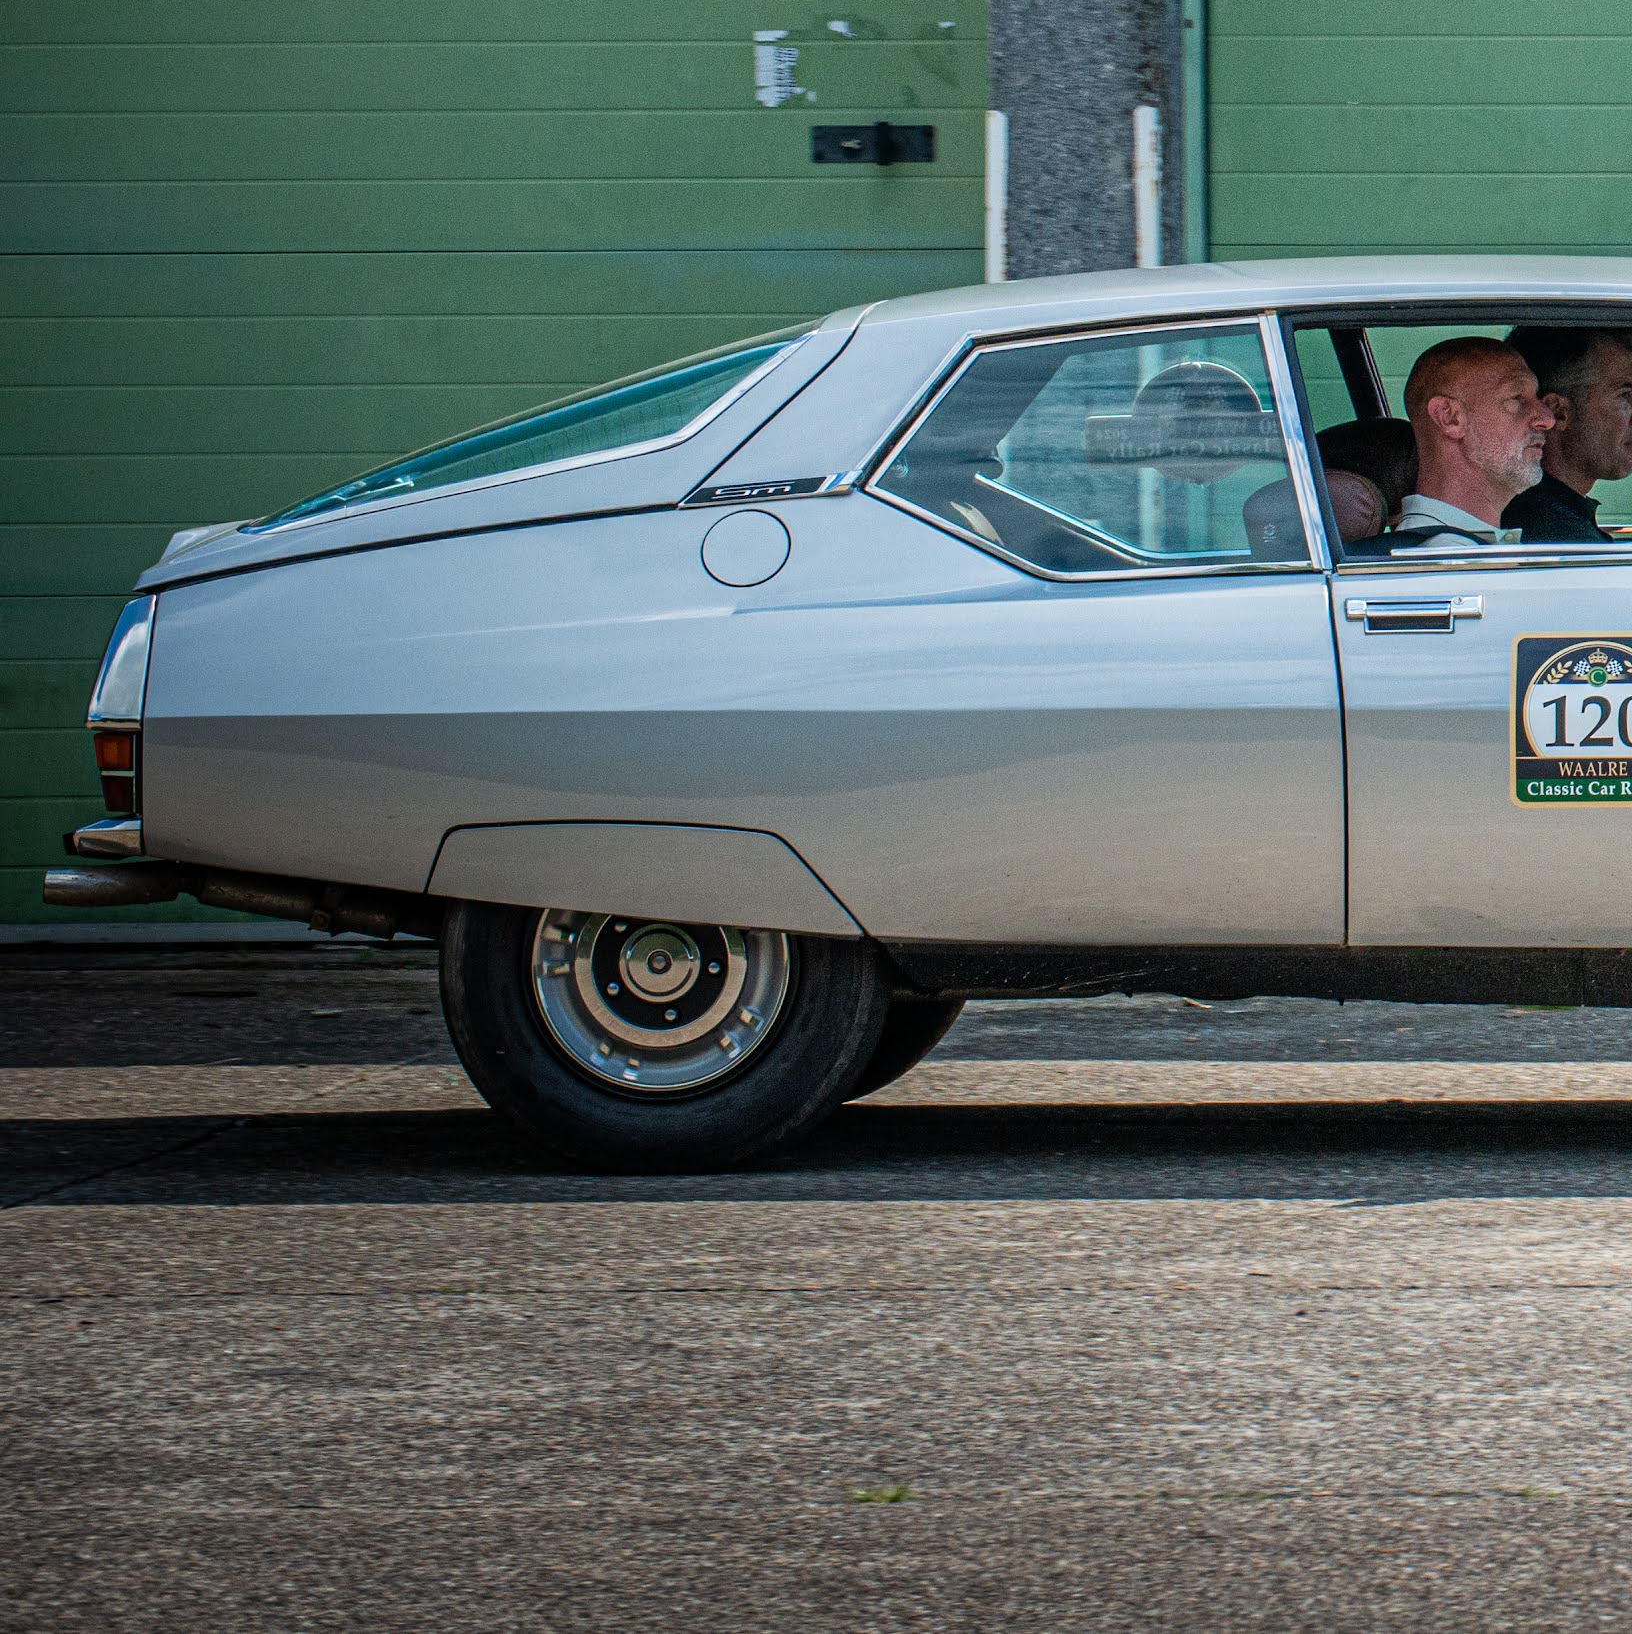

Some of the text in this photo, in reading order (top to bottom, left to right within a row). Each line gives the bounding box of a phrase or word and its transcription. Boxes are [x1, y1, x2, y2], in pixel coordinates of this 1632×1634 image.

[1558, 761, 1628, 777] WAALRE
[1527, 781, 1583, 796] Classic
[1588, 781, 1616, 796] Car
